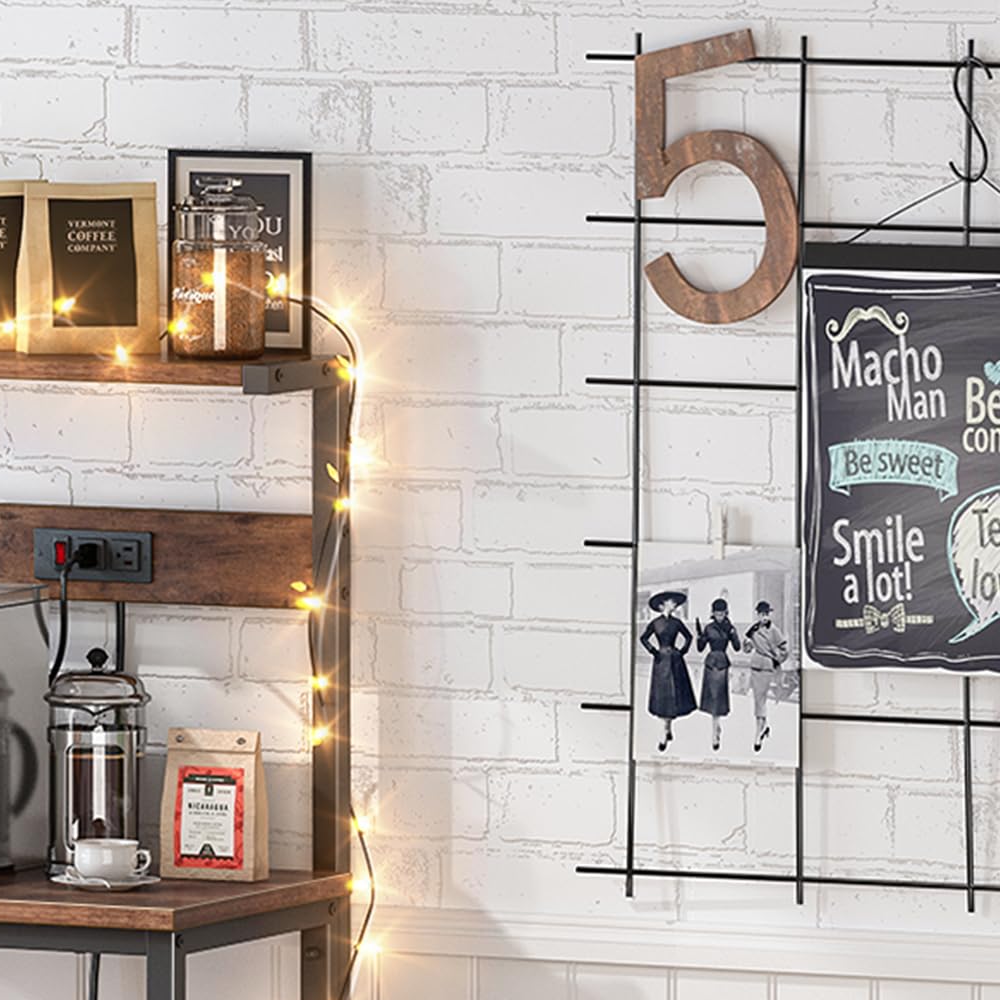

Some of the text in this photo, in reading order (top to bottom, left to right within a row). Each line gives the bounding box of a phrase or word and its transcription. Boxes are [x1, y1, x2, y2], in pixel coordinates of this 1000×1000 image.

[67, 219, 116, 228] VERMONT
[67, 230, 117, 242] COFFEE
[67, 243, 116, 253] COMPANY
[831, 334, 943, 390] Macho
[887, 382, 947, 422] Man
[966, 376, 1000, 425] Be
[845, 449, 944, 479] Be sweet
[832, 515, 925, 567] Smile
[843, 561, 914, 604] a lot!
[972, 558, 1000, 601] lo
